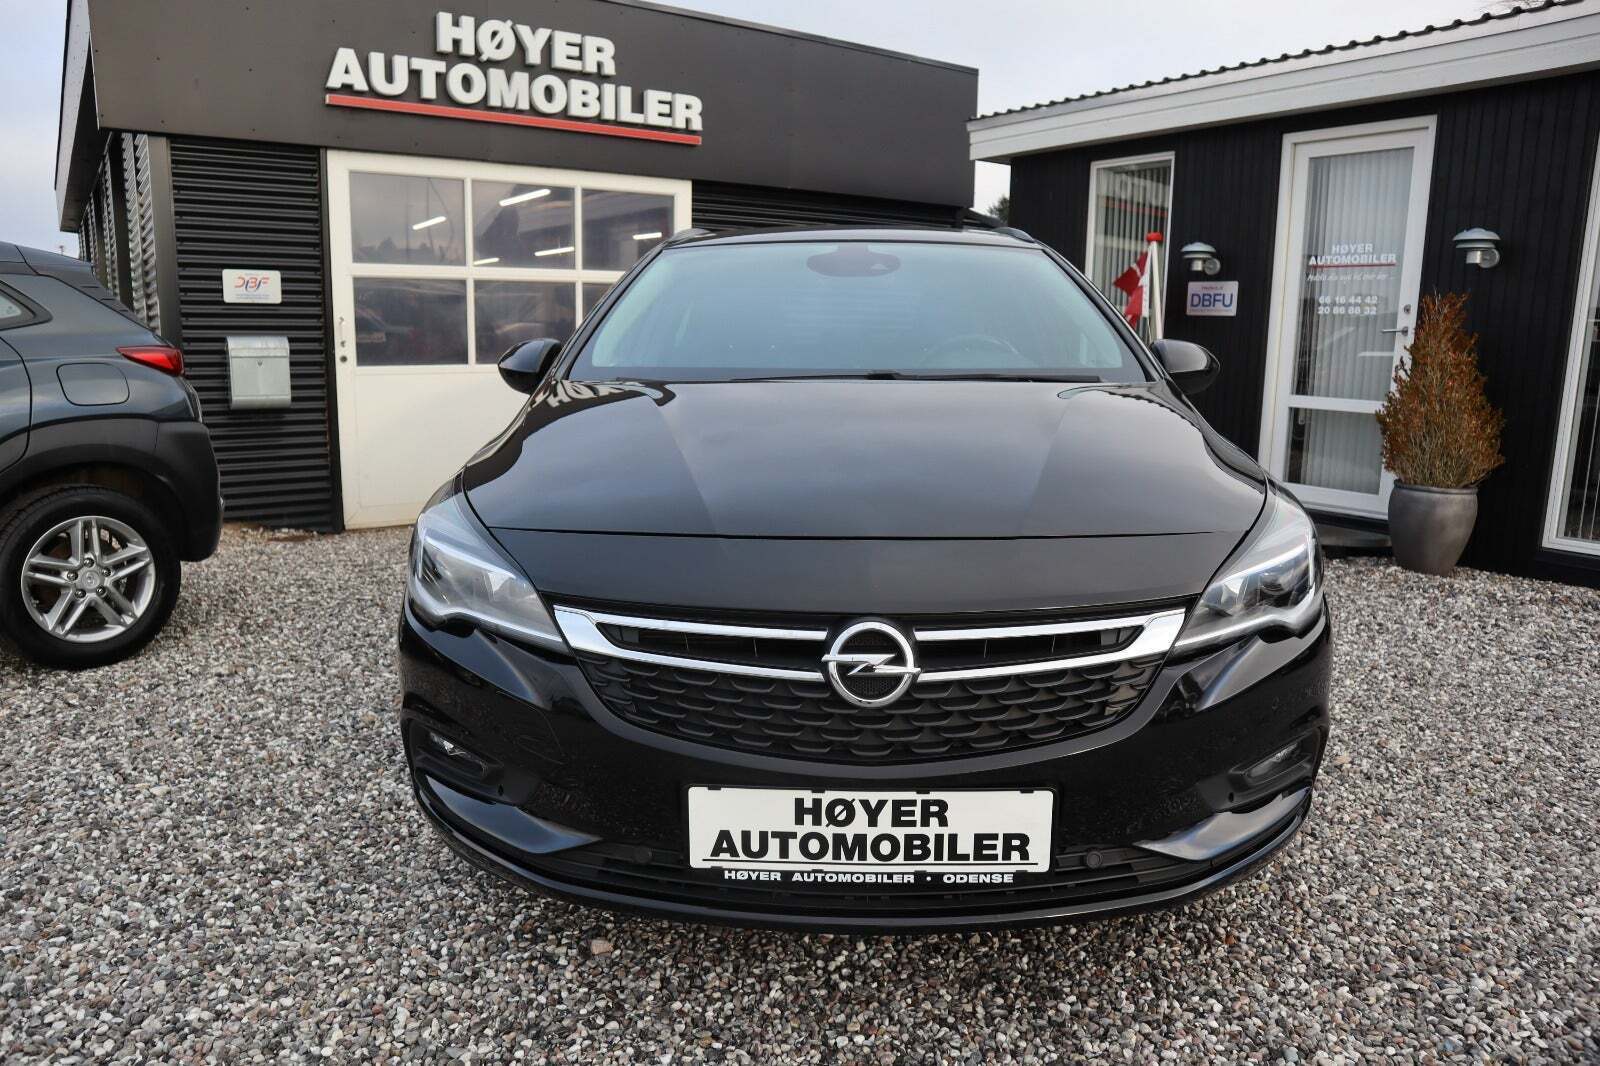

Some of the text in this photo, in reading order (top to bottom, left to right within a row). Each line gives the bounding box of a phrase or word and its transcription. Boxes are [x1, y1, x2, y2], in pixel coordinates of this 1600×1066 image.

[435, 11, 616, 76] HØYER
[325, 47, 703, 131] AUTOMOBILER
[1308, 254, 1397, 266] AUTOMOBILER
[1331, 243, 1374, 255] HØYER
[1190, 292, 1233, 308] DBFU
[794, 797, 949, 828] HØYER
[709, 829, 1031, 862] AUTOMOBILER
[724, 870, 1014, 884] HØYER AUTOMOBILER ODENSE
